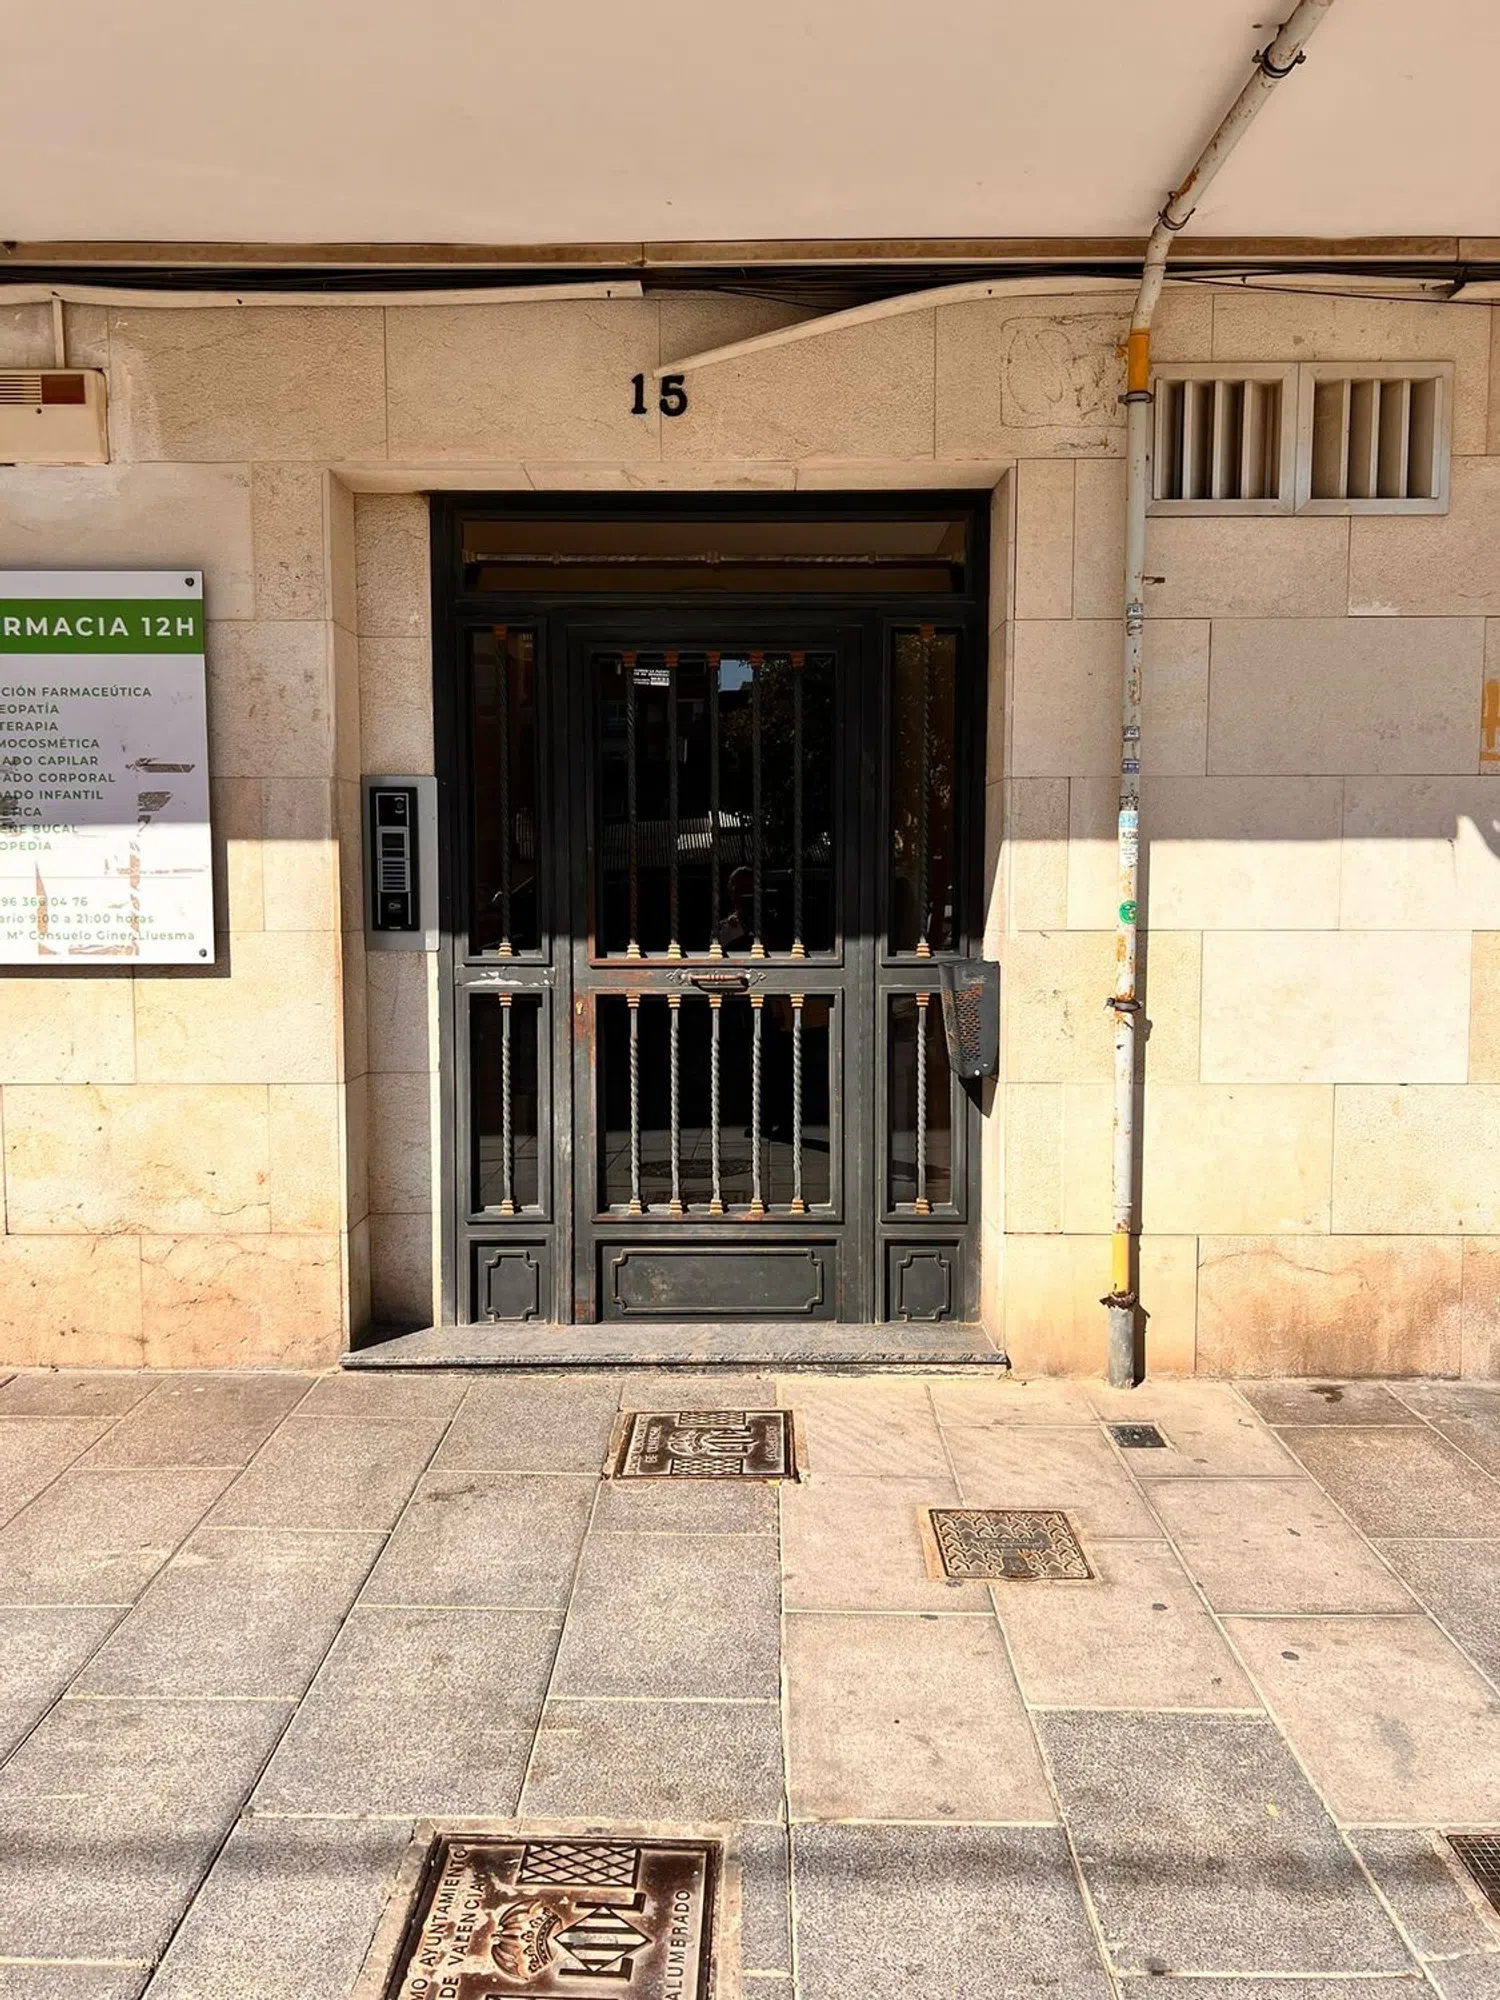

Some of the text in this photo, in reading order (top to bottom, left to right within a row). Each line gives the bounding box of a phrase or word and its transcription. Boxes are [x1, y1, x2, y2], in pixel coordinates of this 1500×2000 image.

[631, 373, 688, 417] 15
[4, 617, 195, 636] RMACIA 12H
[42, 685, 152, 698] FARMACEÚTICA
[38, 756, 99, 766] CAPILAR
[39, 773, 116, 783] CORPORAL
[0, 790, 104, 800] ADO INFANTIL
[32, 824, 78, 834] BUCAL
[51, 897, 68, 907] 04
[72, 897, 89, 907] 76
[76, 913, 111, 924] 21:00
[28, 930, 92, 941] Consuelo
[138, 930, 195, 941] Lluesma
[419, 1849, 469, 1967] AYUNTAMIENTO
[439, 1881, 486, 1999] DE VALENCIA
[664, 1890, 691, 2000] ALUMBRADO
